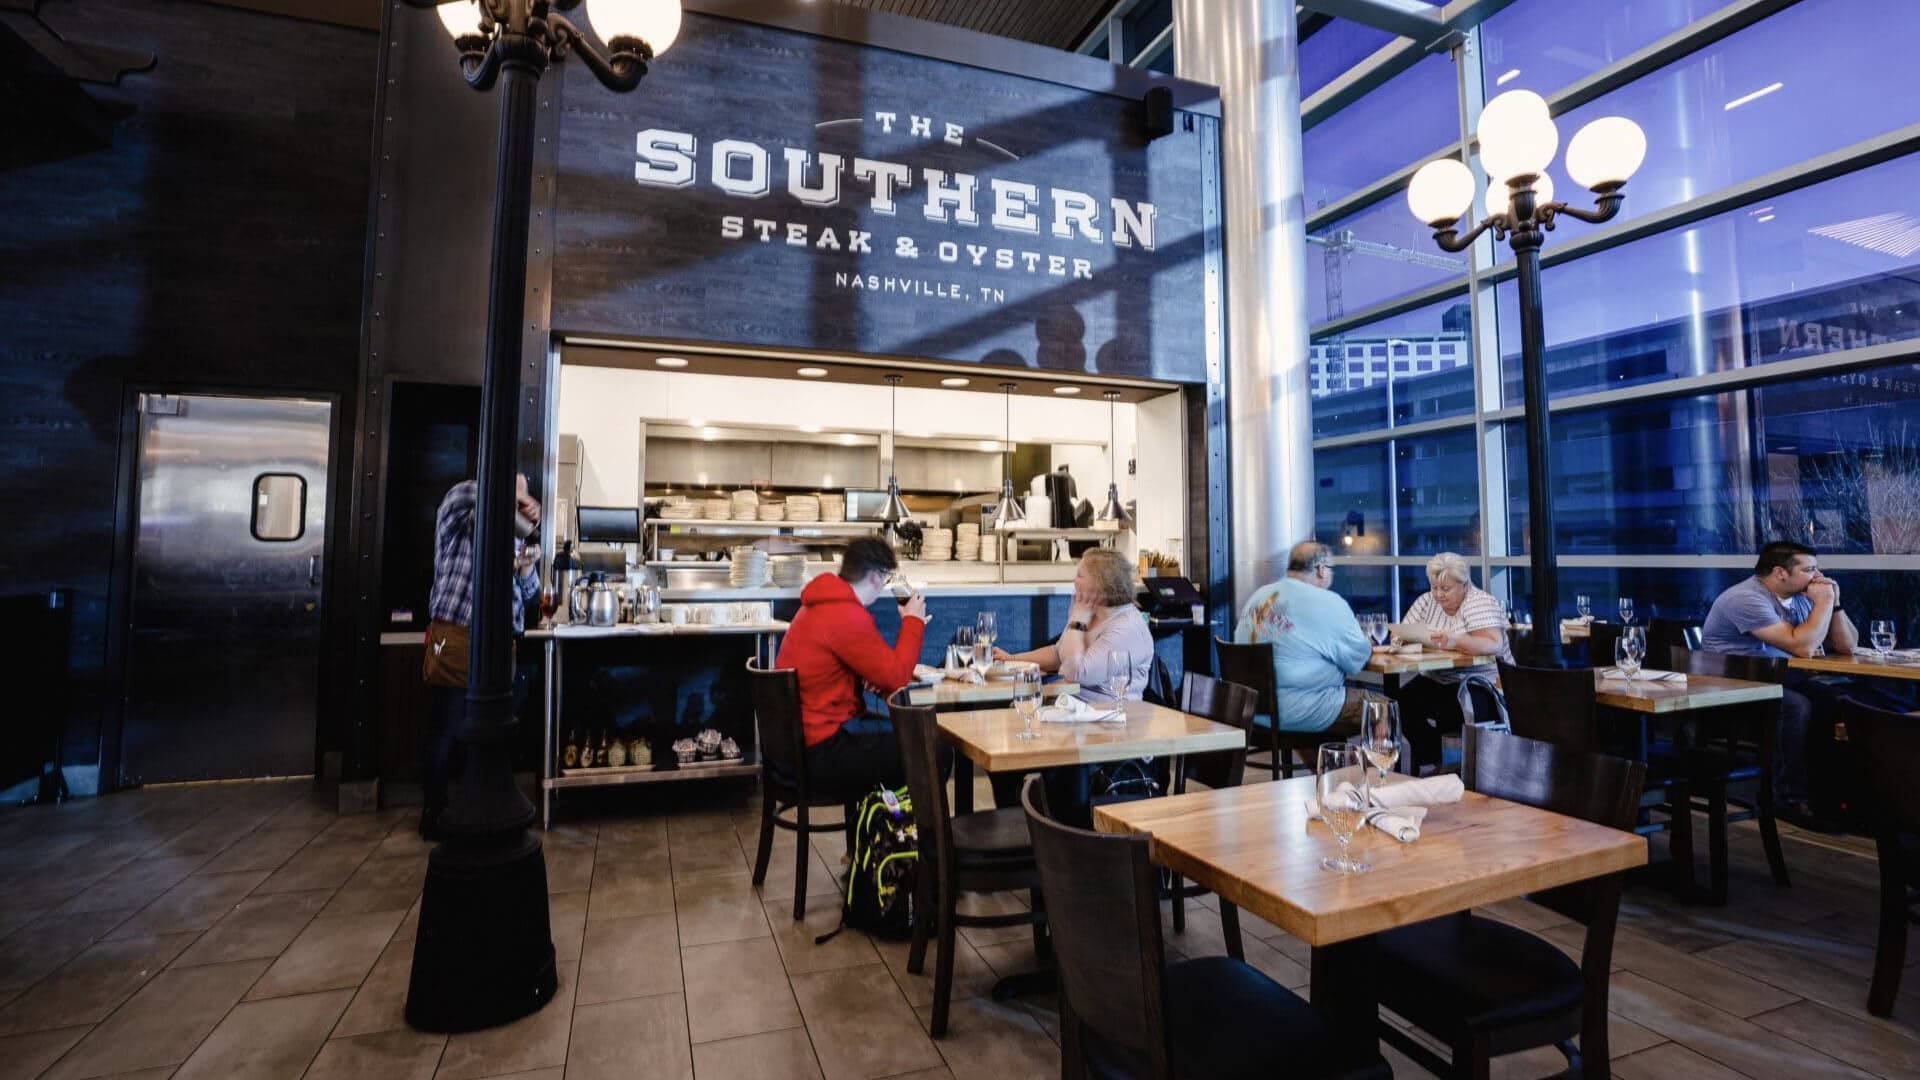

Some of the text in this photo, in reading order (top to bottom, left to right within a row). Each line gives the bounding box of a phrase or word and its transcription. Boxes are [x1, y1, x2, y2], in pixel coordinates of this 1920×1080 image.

[875, 111, 964, 146] THE
[634, 128, 1157, 251] SOUTHERN
[721, 215, 1093, 280] STEAK & OYSTER
[835, 271, 1004, 303] NASHVILLE, TN
